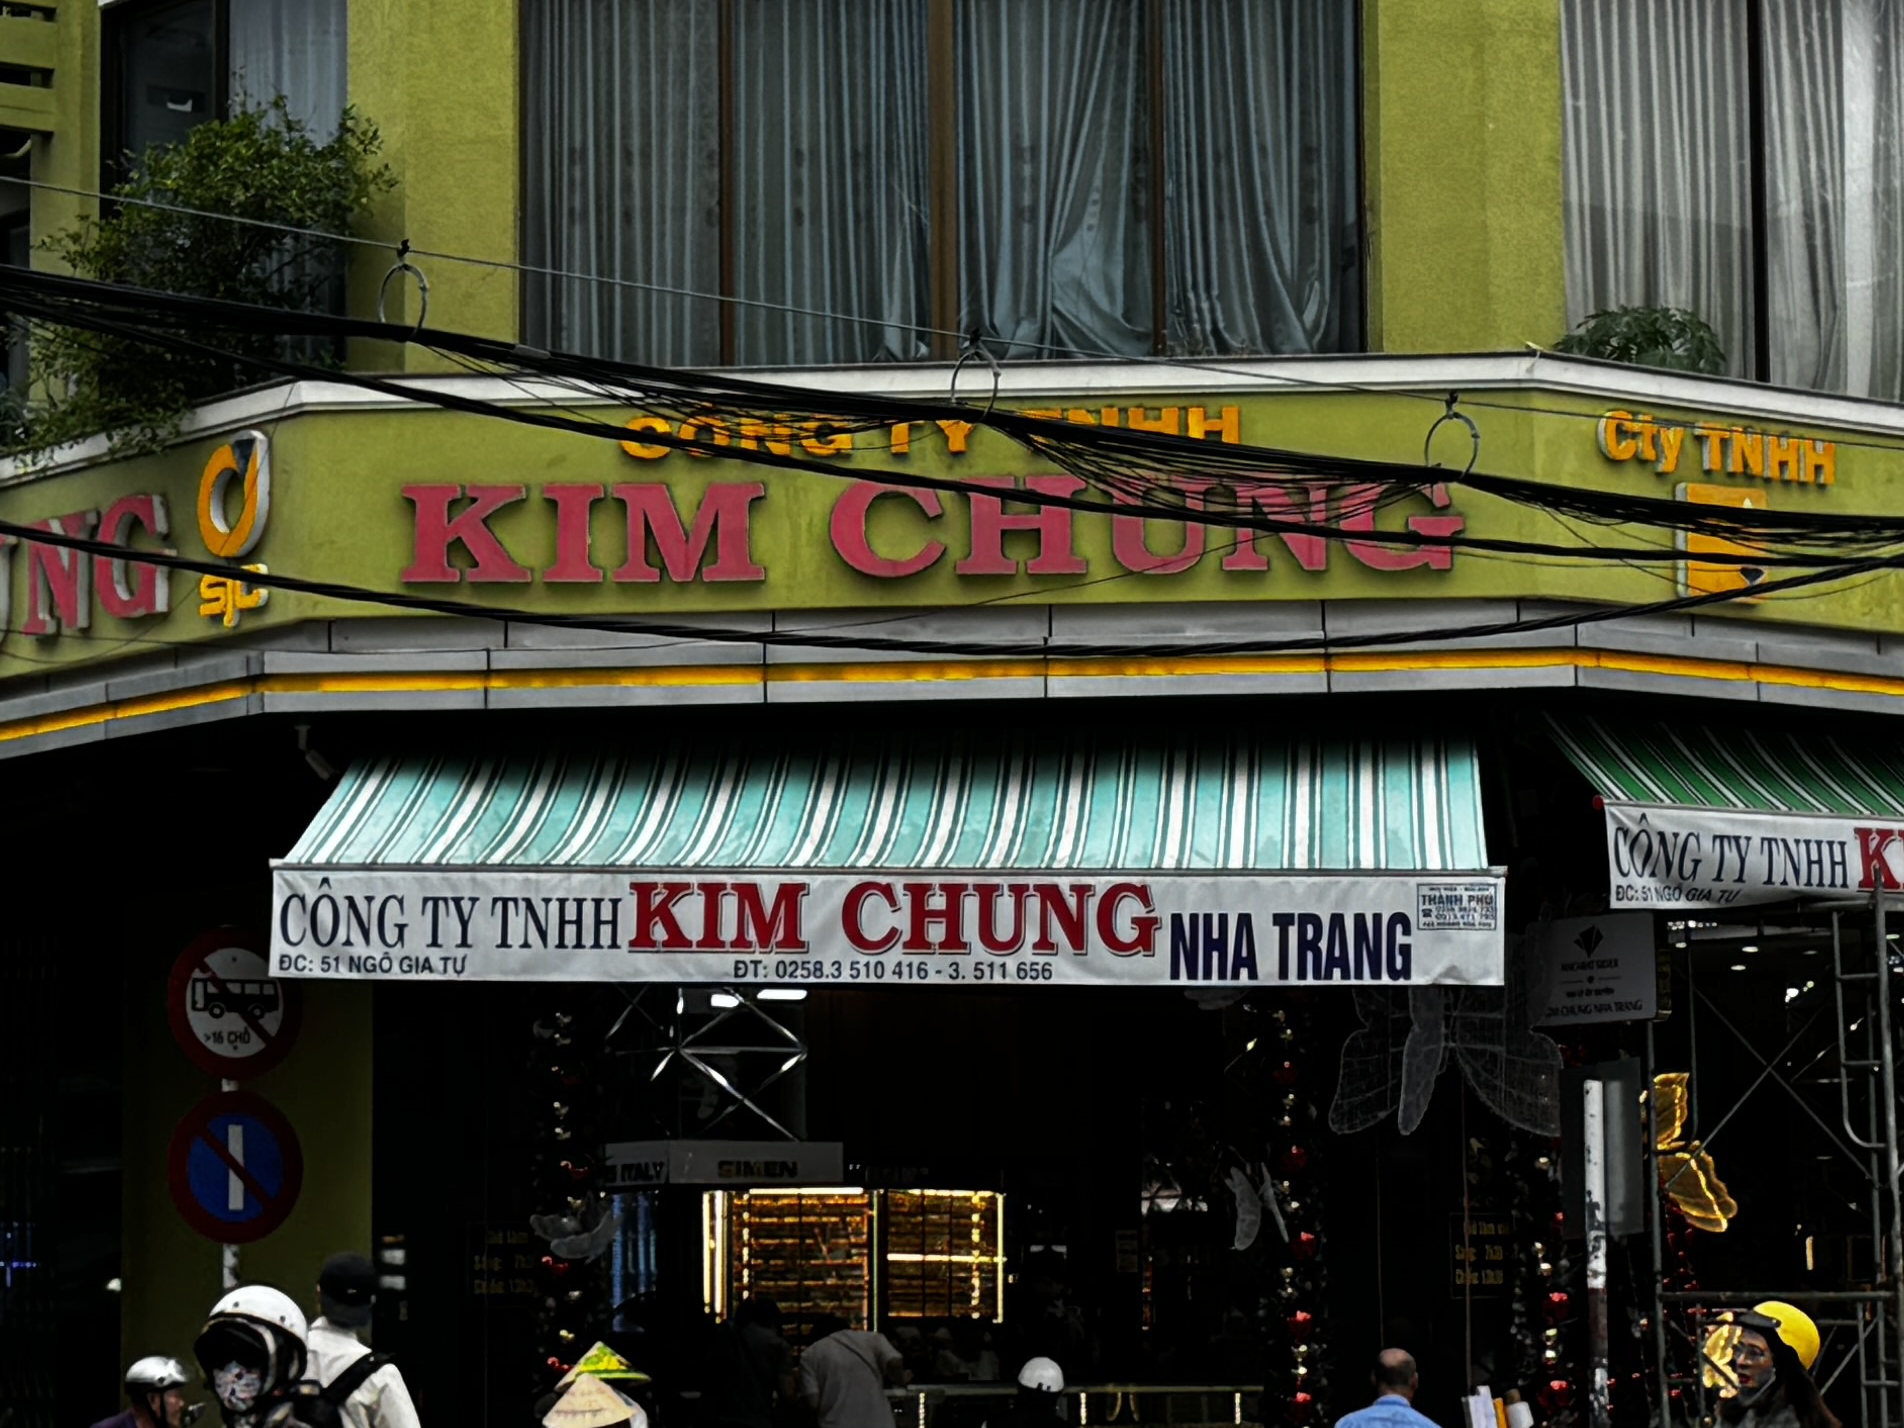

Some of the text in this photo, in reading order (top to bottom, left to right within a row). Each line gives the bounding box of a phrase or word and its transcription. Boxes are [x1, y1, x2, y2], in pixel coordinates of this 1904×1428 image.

[1599, 411, 1835, 485] Cty TNHH
[401, 470, 1465, 583] KIM CHUNG
[1613, 813, 1700, 882] CÔNG
[1711, 836, 1752, 885] TY
[1760, 838, 1849, 889] TNHH
[278, 954, 314, 974] ĐC:
[320, 954, 342, 974] 51
[399, 955, 433, 976] GIA
[279, 876, 1412, 981] CÔNG TY TNHH KIM CHUNG NHA TRANG
[734, 959, 769, 979] ĐT:
[775, 960, 844, 980] 0258.3
[849, 960, 887, 980] 510
[891, 961, 928, 980] 416
[975, 961, 1012, 980] 511
[1016, 961, 1053, 980] 656
